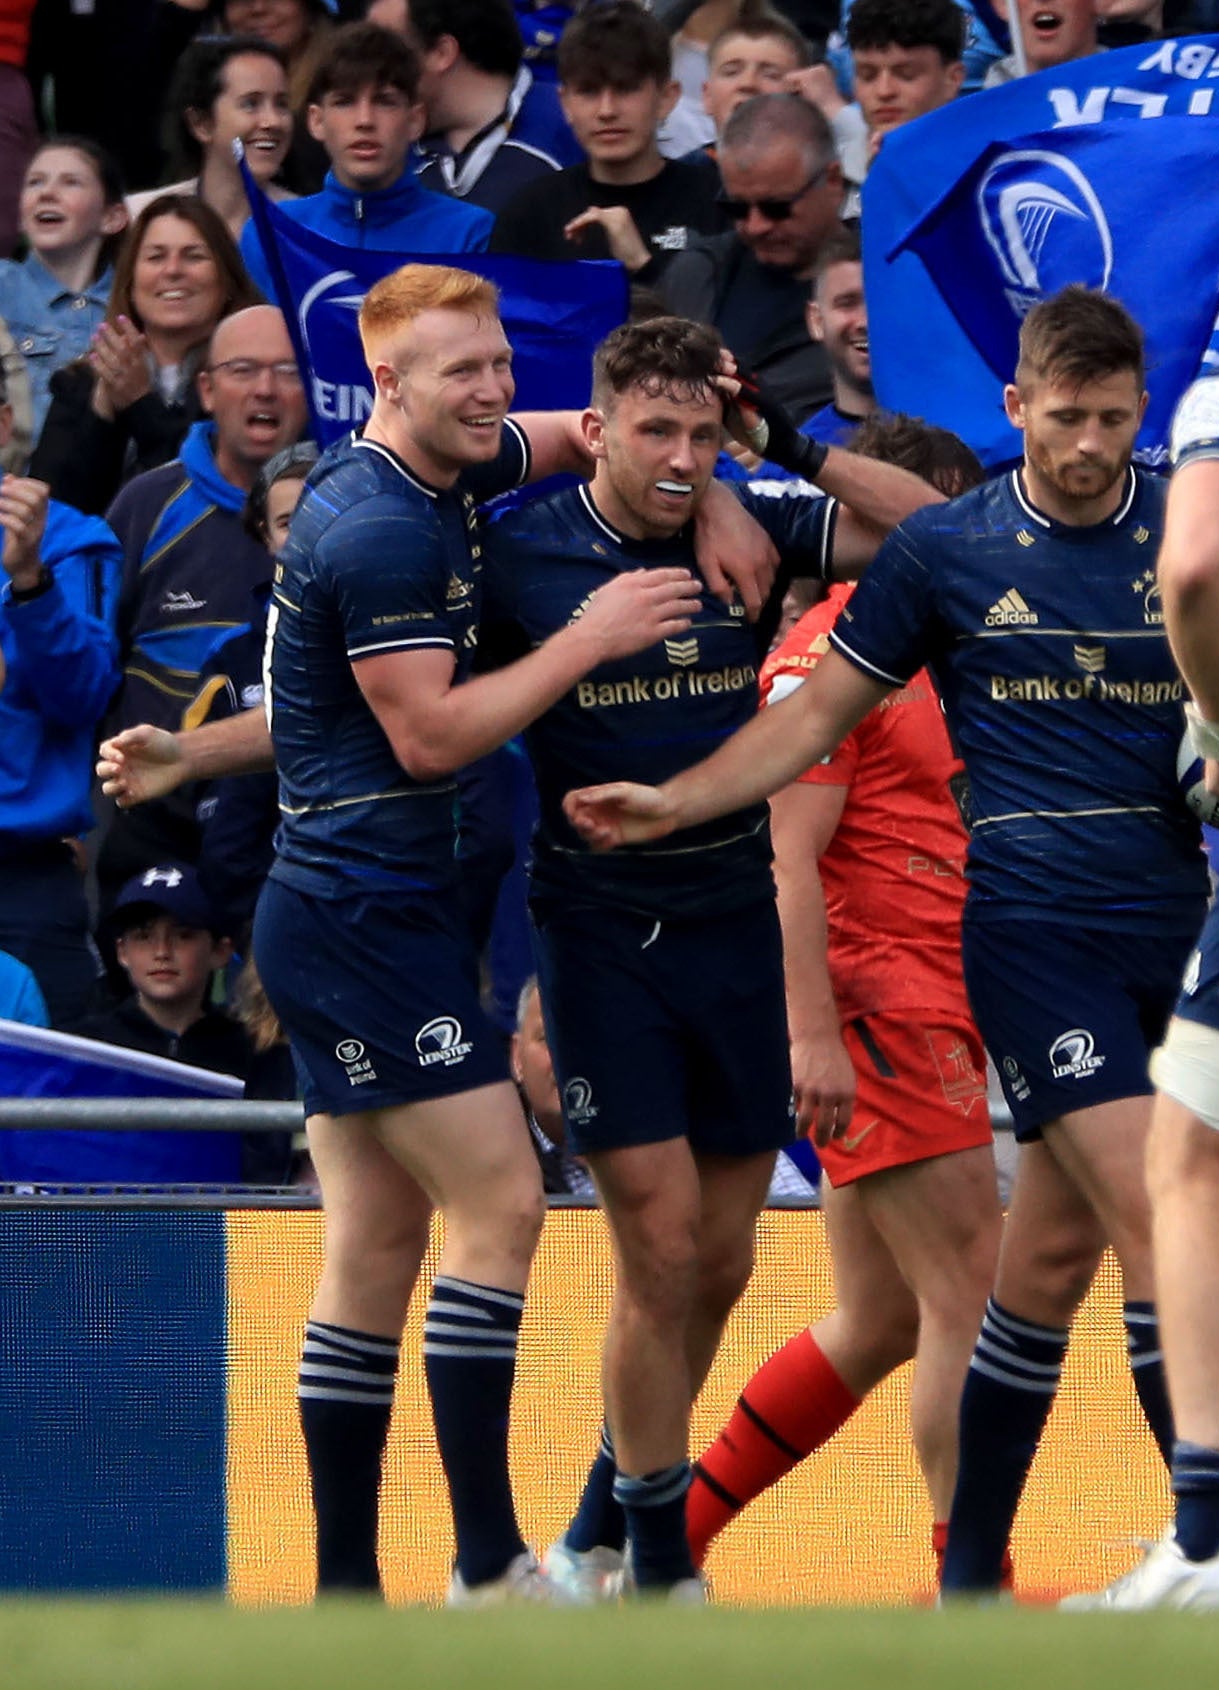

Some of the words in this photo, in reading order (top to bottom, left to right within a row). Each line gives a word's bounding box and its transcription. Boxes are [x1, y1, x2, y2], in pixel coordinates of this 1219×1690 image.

[984, 610, 1039, 627] adidas
[577, 675, 651, 709] Bank
[654, 670, 684, 701] of
[990, 674, 1061, 702] Bank
[1063, 673, 1096, 699] of
